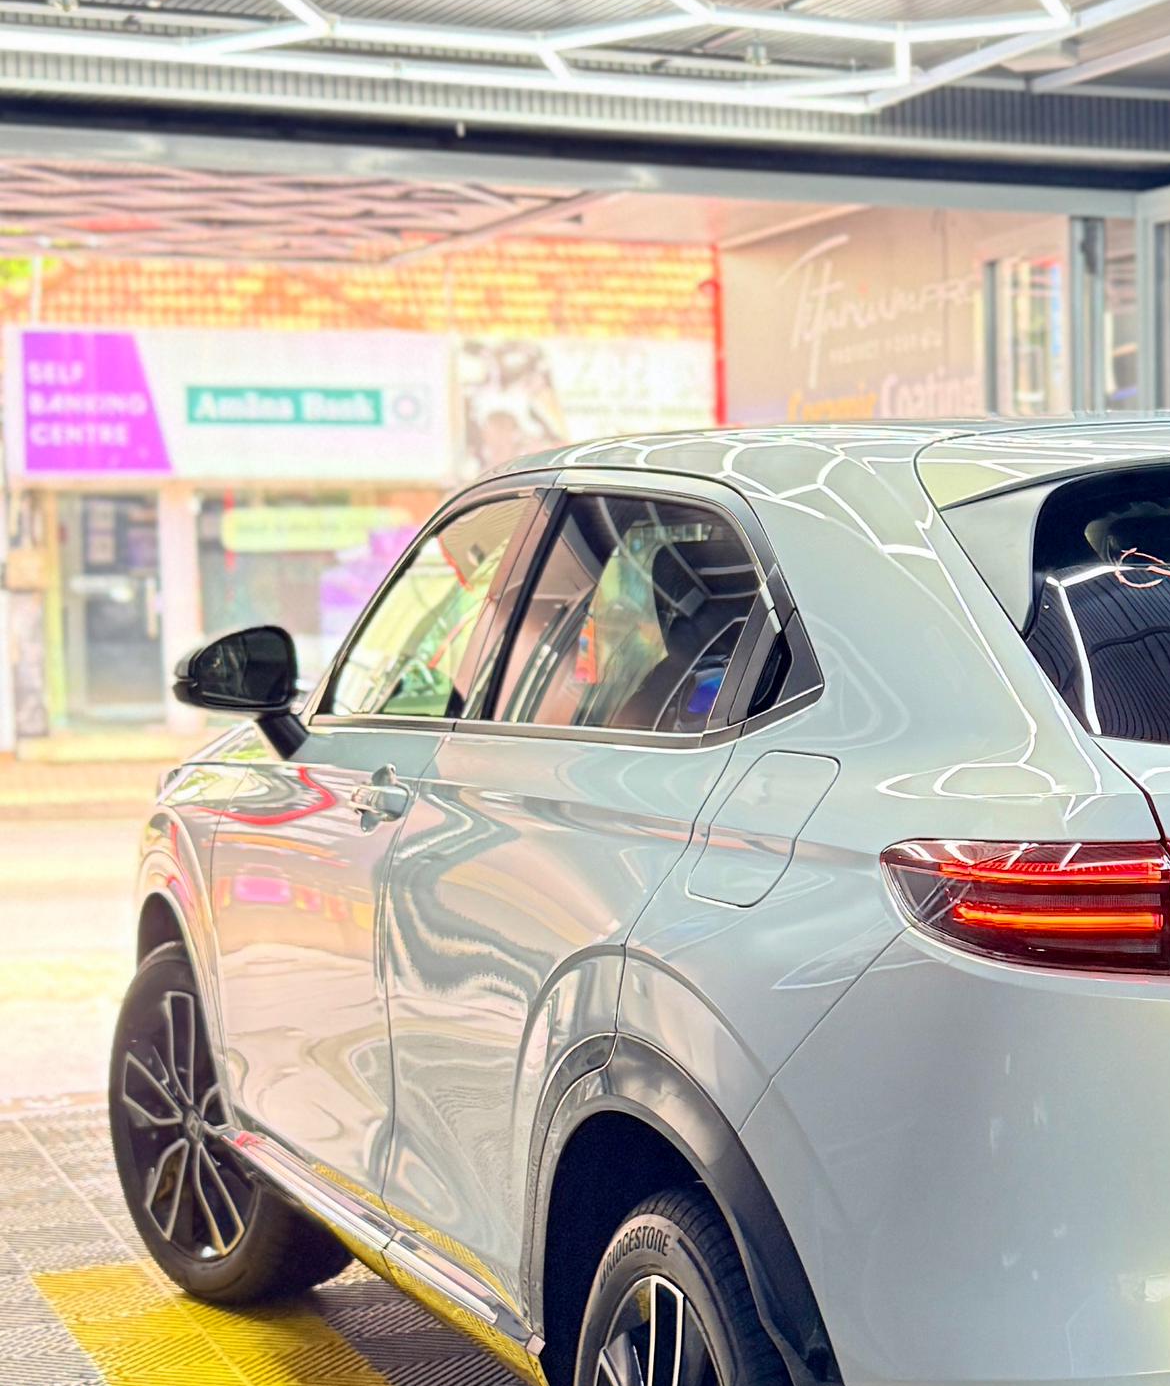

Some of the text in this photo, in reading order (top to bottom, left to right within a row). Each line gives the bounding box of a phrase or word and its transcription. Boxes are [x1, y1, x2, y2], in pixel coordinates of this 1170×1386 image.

[27, 363, 83, 385] SELF
[28, 393, 148, 415] BANKING
[302, 392, 376, 421] Bank
[29, 424, 128, 447] CENTRE
